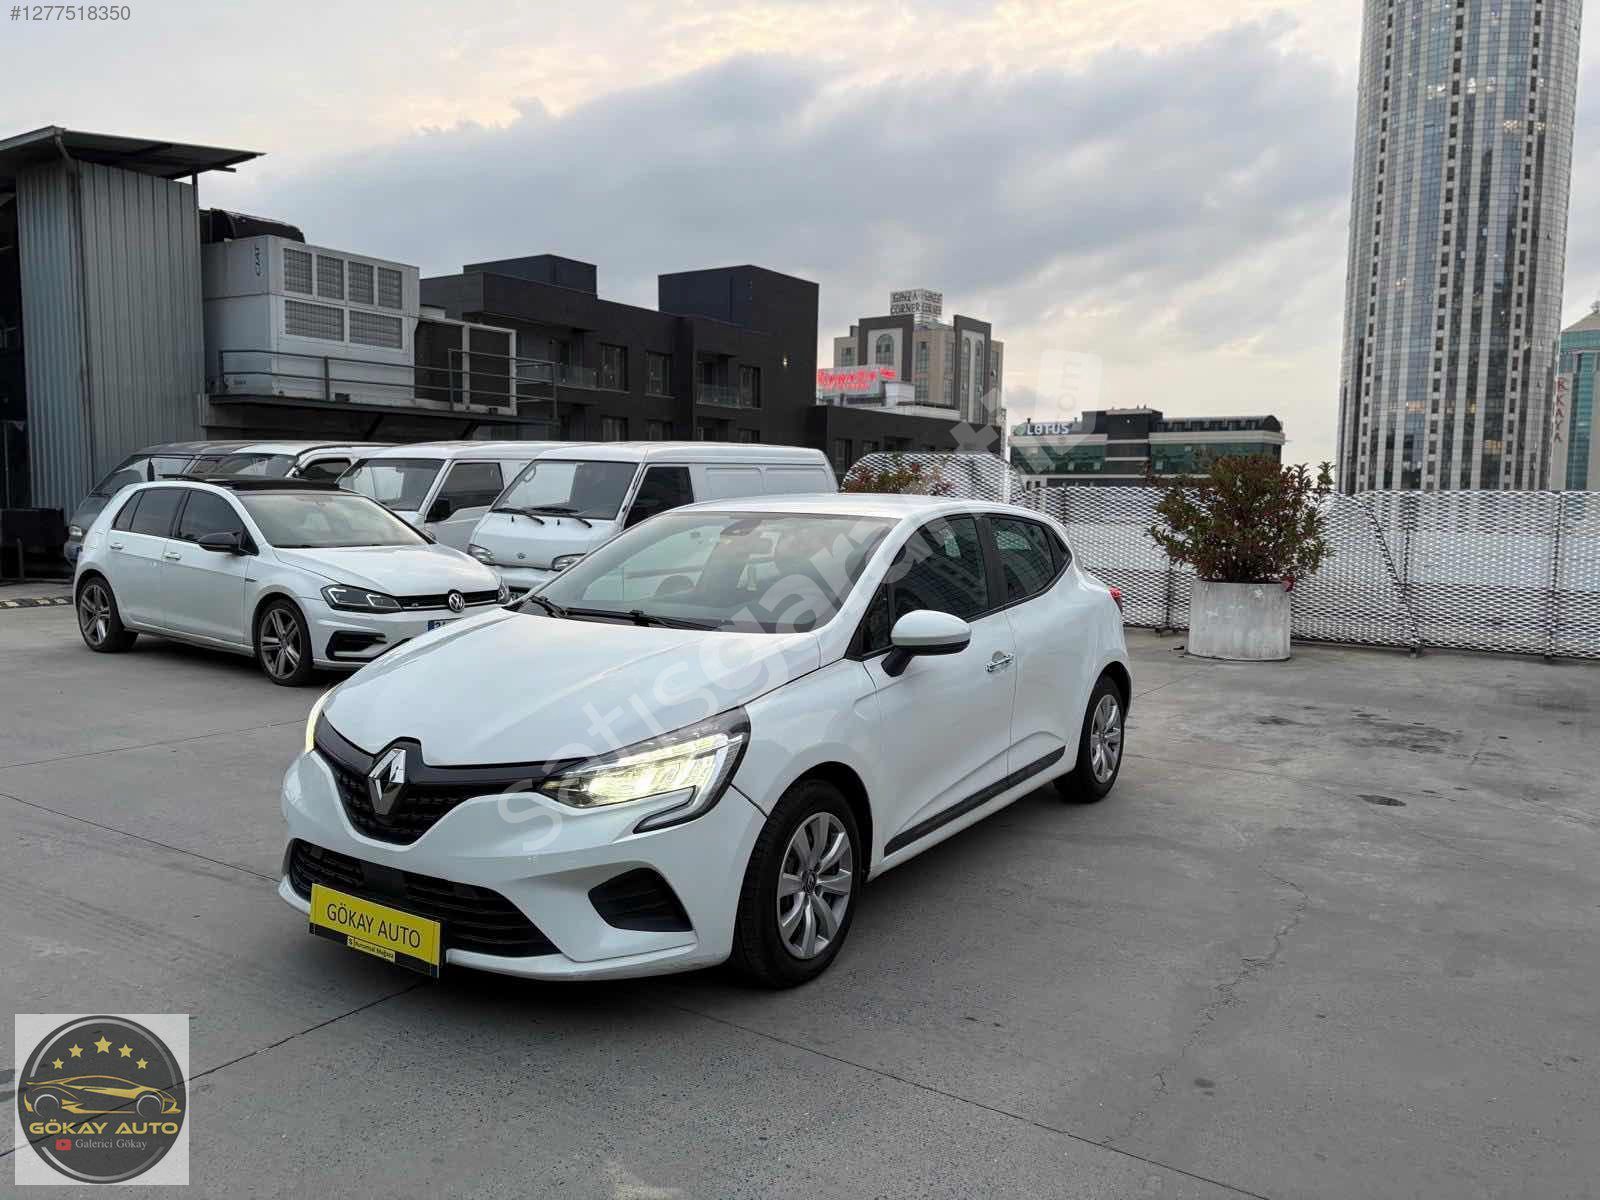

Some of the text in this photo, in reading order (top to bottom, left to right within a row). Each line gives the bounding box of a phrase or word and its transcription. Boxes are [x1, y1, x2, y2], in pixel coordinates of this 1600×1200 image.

[1026, 423, 1070, 435] LOTUS
[327, 903, 420, 947] GÖKAY AUTO
